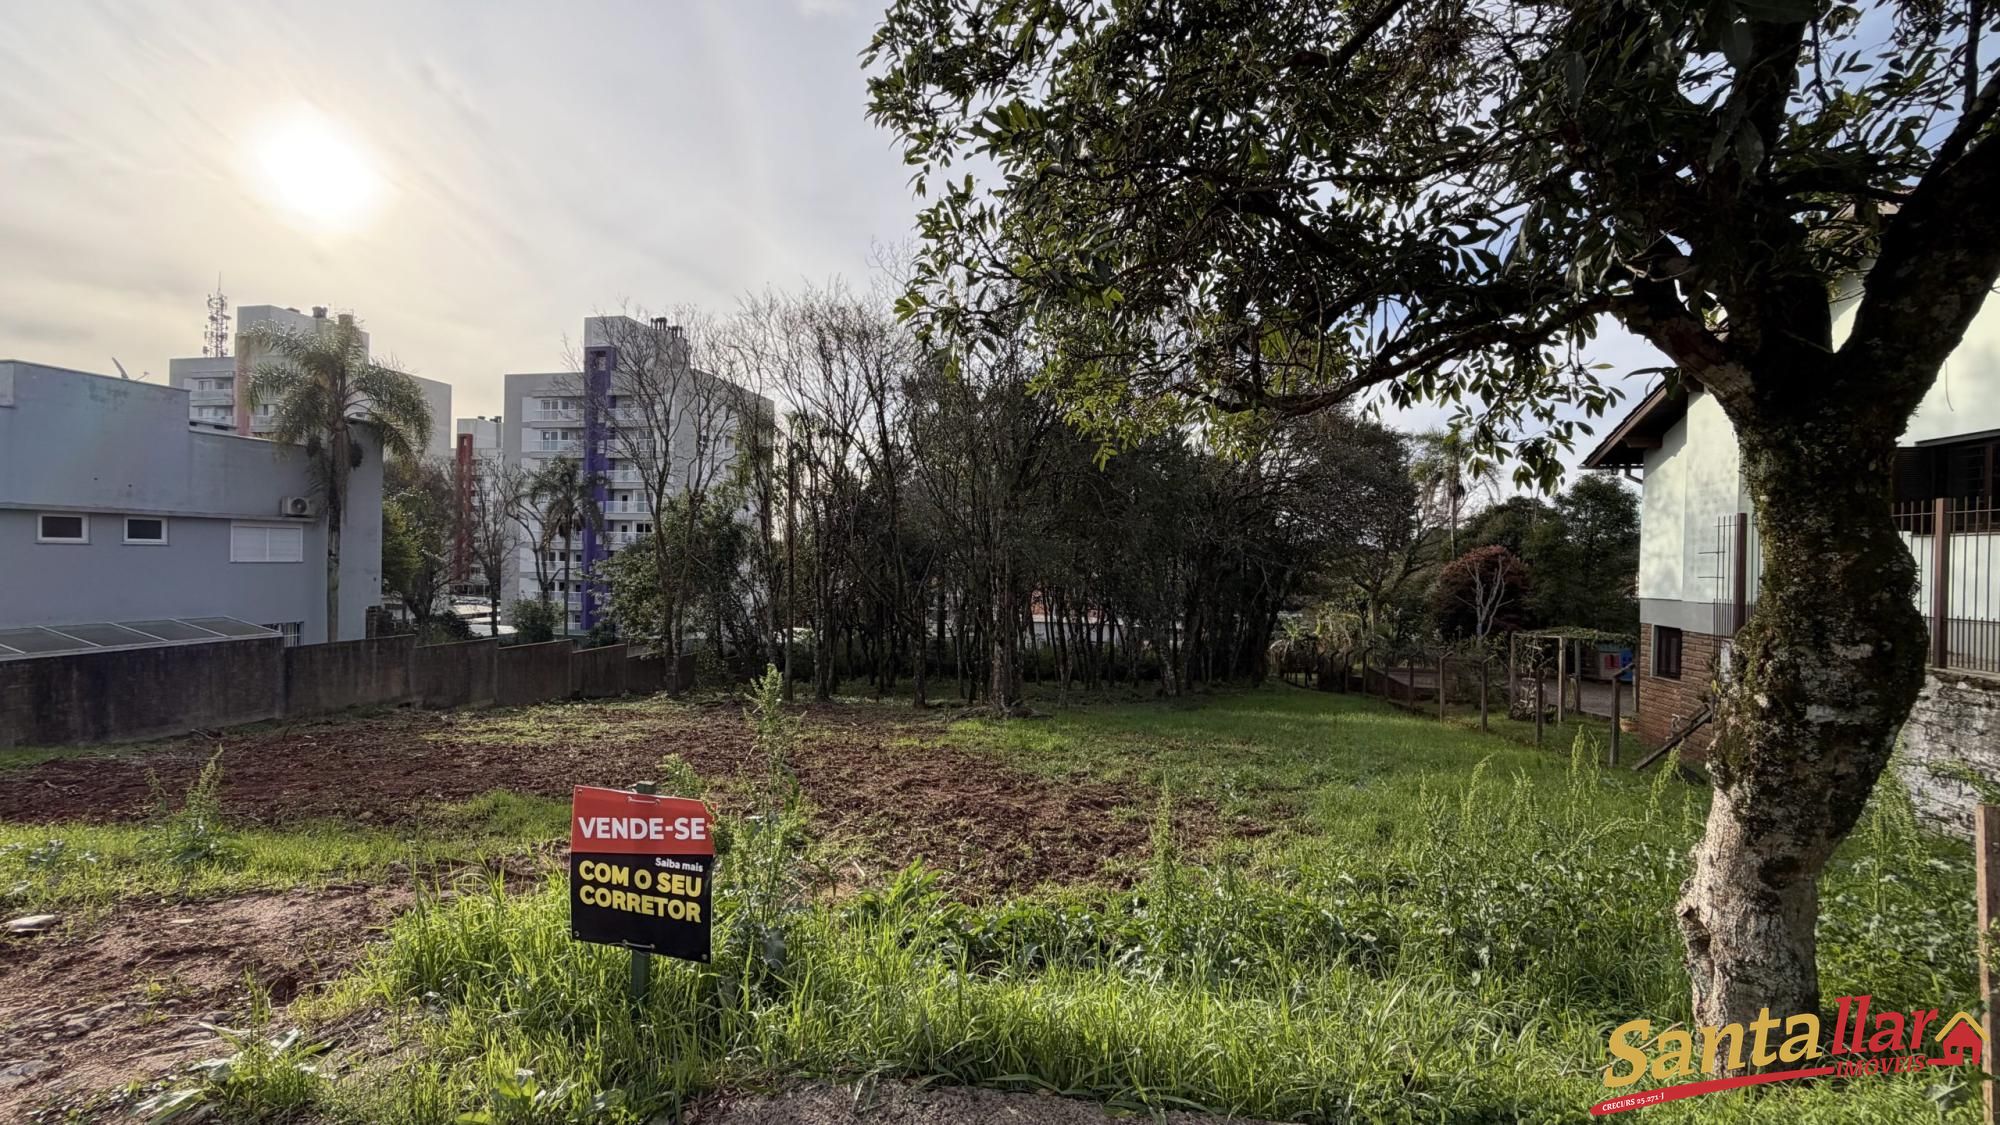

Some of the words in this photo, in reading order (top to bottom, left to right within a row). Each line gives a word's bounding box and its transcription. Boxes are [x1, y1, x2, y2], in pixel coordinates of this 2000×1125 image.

[578, 817, 706, 840] VENDE-SE
[579, 860, 630, 887] COM
[634, 868, 652, 890] O
[656, 872, 702, 897] SEU
[655, 857, 680, 869] Saiba
[682, 862, 704, 872] mais
[579, 885, 702, 923] CORRETOR
